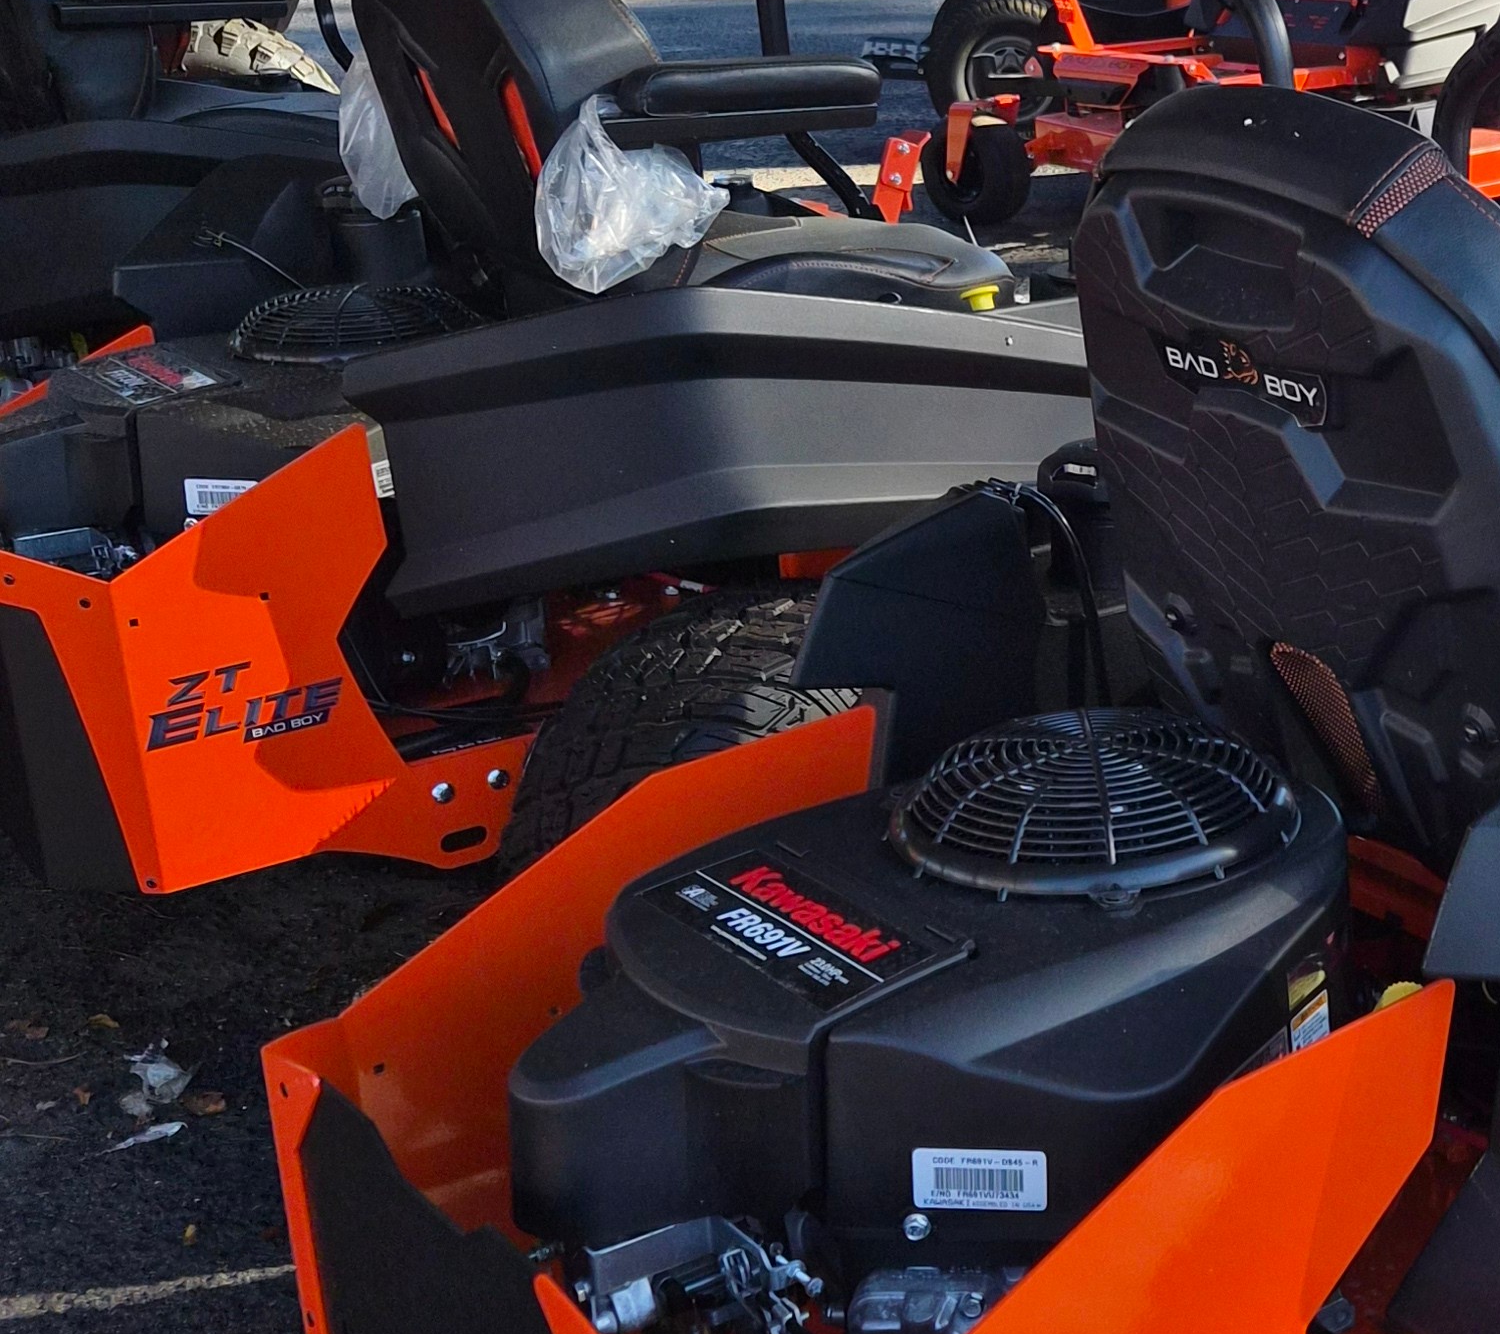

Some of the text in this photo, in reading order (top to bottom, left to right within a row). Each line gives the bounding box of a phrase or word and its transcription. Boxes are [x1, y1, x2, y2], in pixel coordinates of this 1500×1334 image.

[1165, 346, 1318, 407] BAD BOY
[166, 661, 252, 708] ZT
[146, 676, 343, 752] ELITE
[251, 712, 324, 739] BAD BOY
[715, 907, 812, 958] FR691V
[729, 866, 901, 964] Kawasaki
[932, 1156, 954, 1165] CODE
[923, 1198, 971, 1206] KAWASAKI
